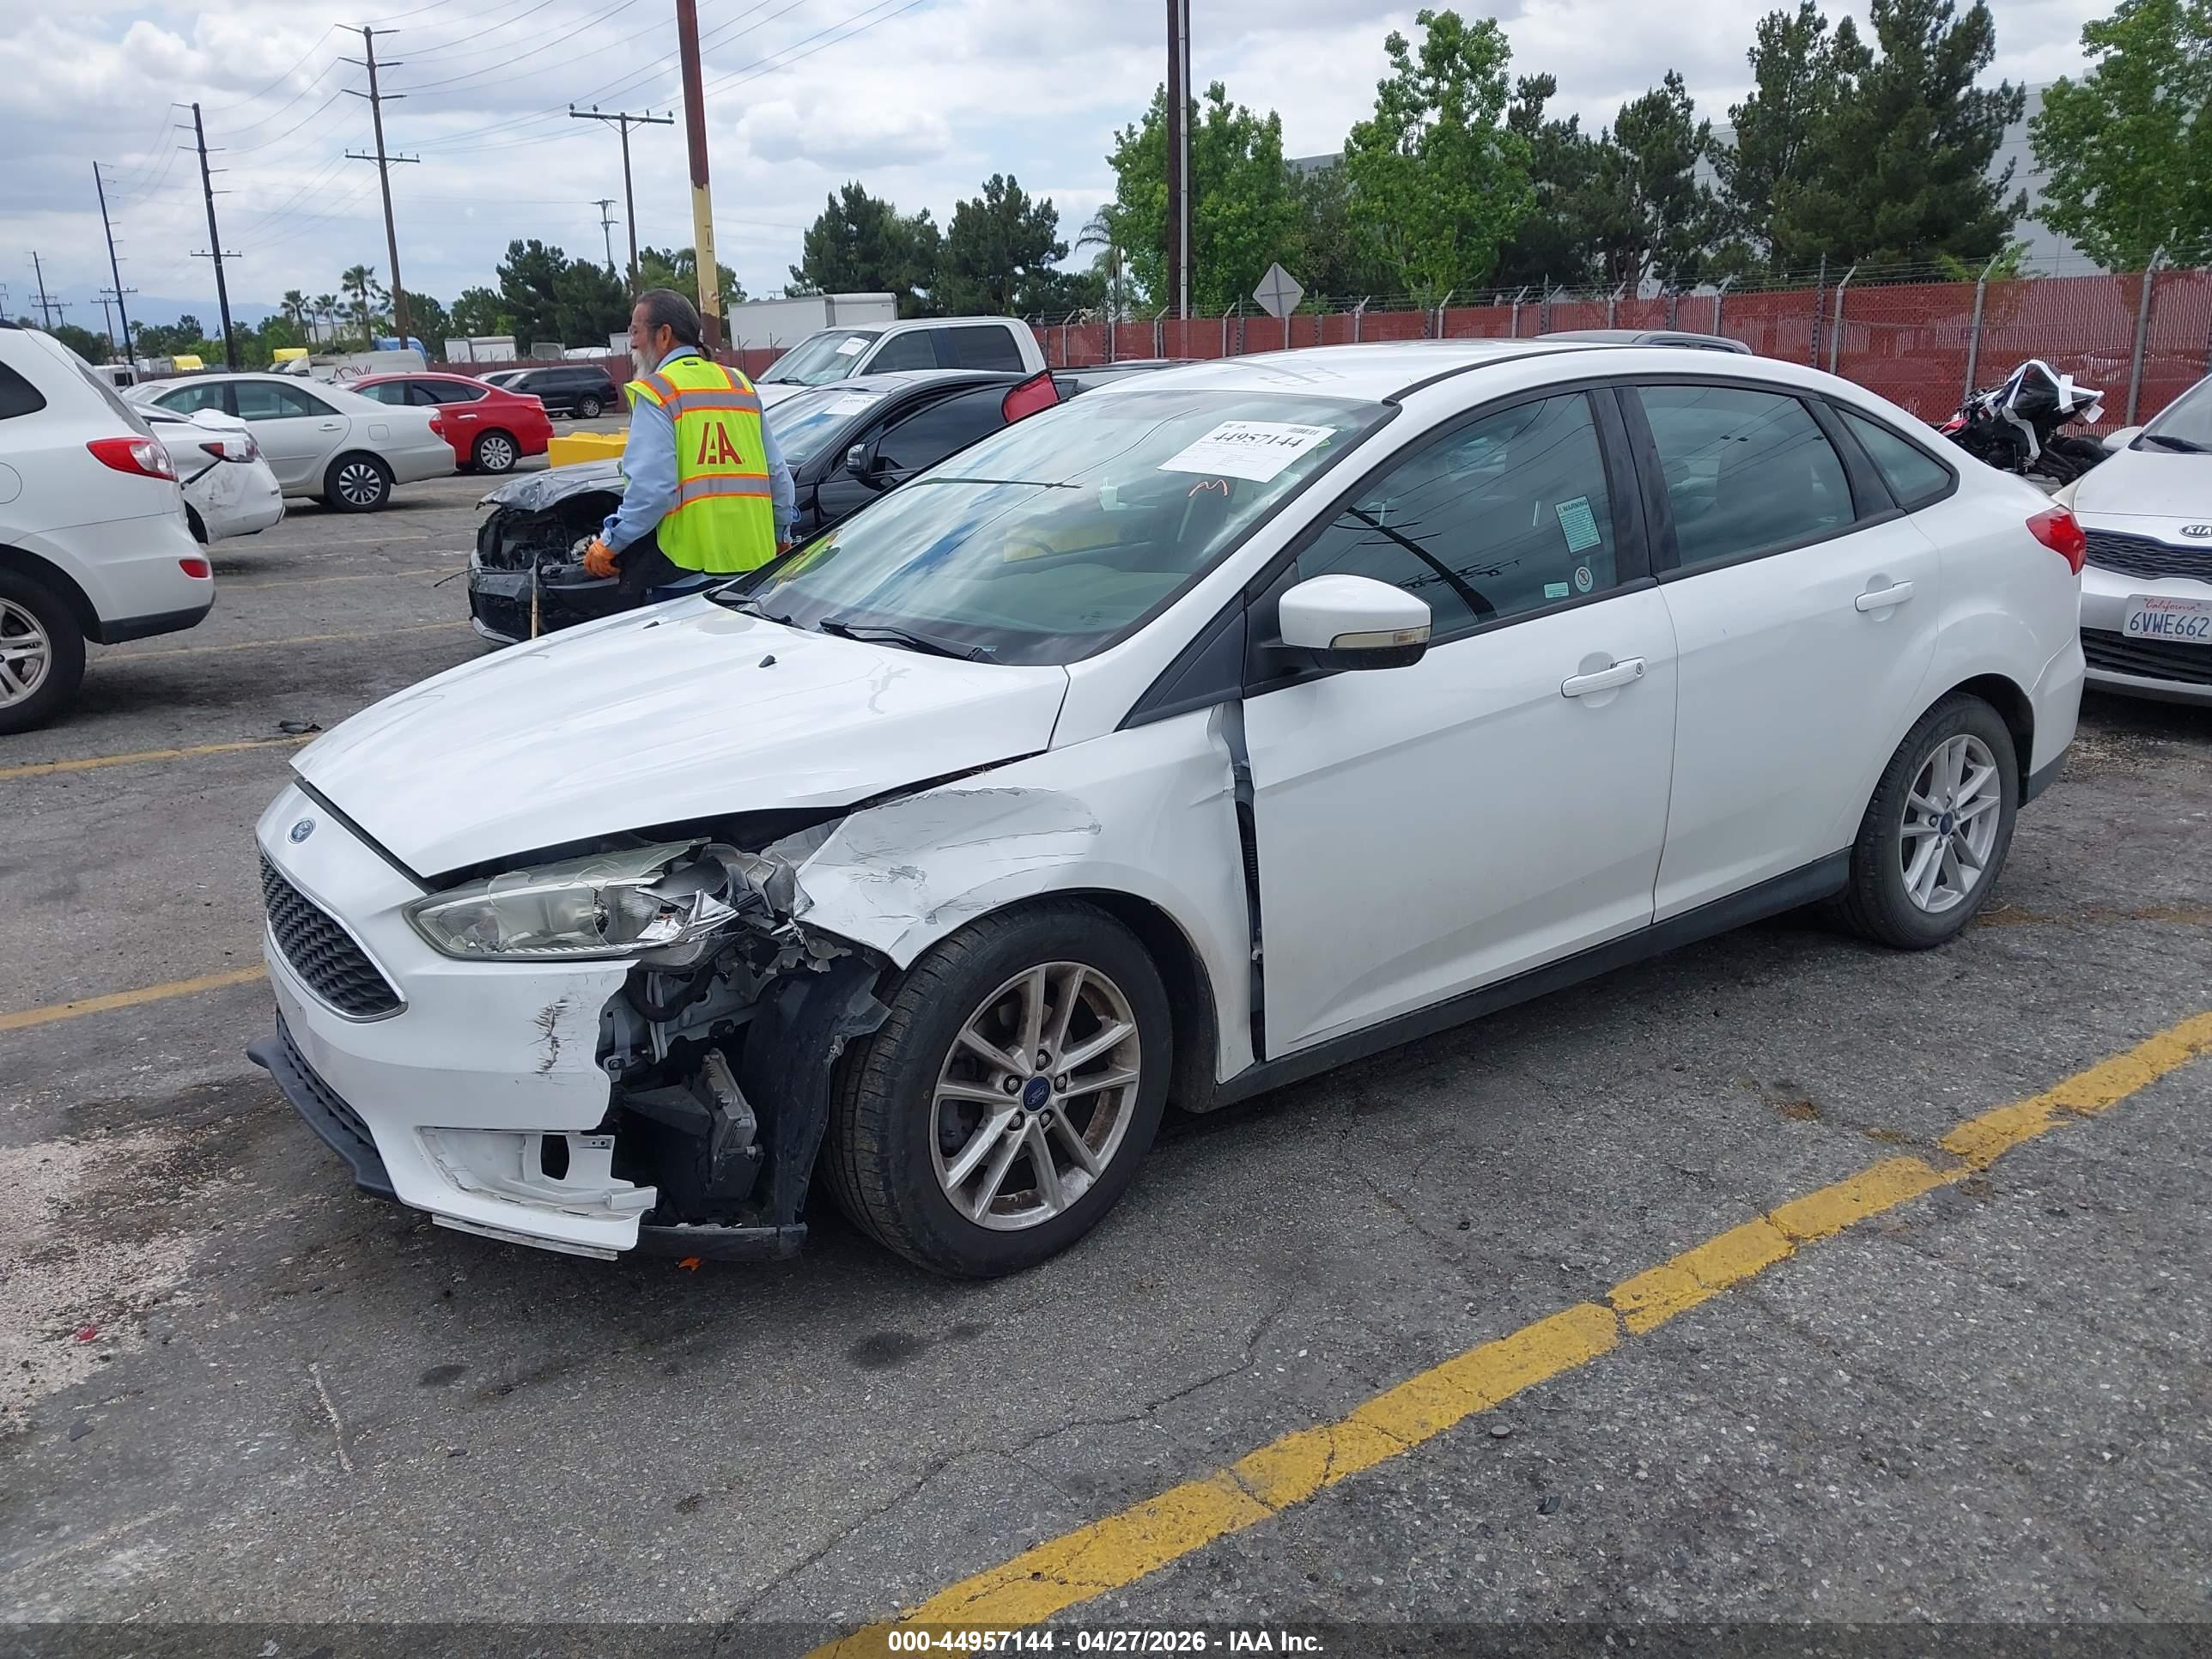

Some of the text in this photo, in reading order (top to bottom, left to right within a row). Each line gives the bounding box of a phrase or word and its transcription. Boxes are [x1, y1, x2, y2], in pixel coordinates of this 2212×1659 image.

[1212, 432, 1305, 447] 44957144
[1563, 499, 1588, 513] WARNING
[2185, 526, 2212, 534] KIA
[2146, 598, 2200, 612] California
[2130, 611, 2210, 637] 6VWE662
